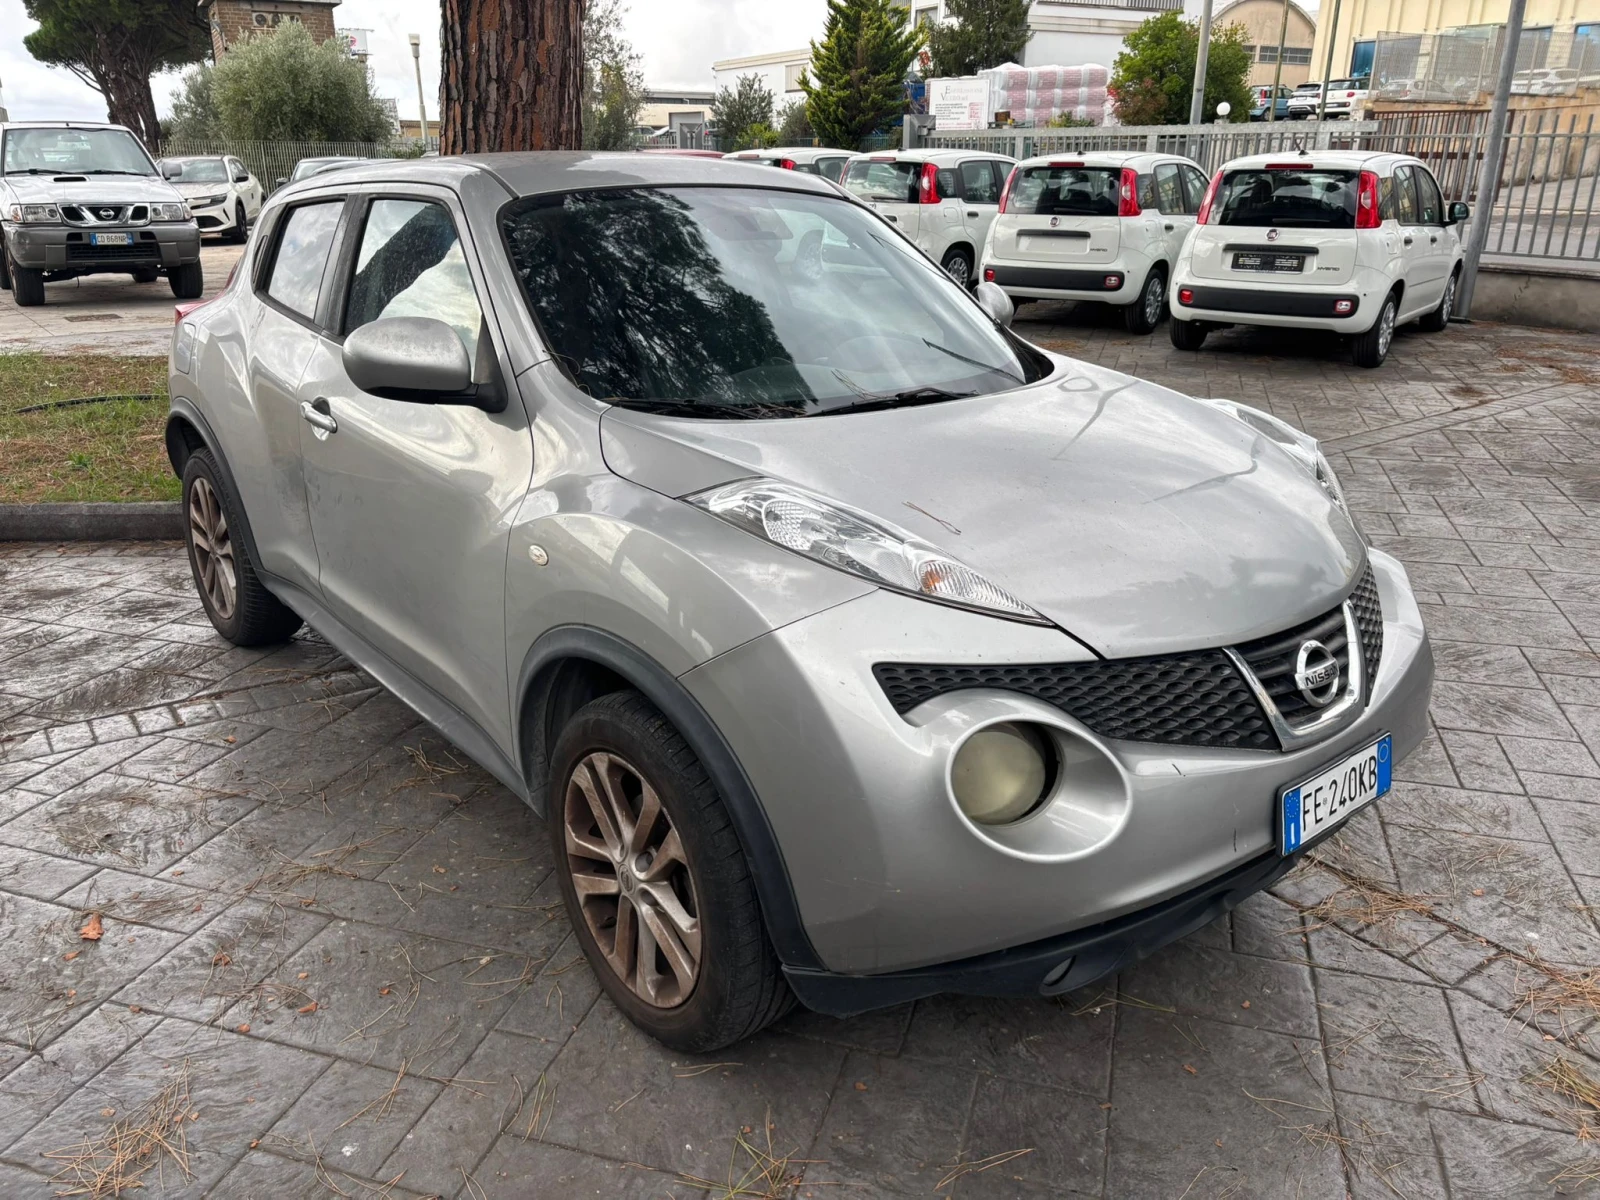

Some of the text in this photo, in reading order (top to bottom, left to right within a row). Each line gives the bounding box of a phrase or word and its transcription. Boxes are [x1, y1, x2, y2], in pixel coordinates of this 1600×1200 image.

[1304, 664, 1338, 687] NISSAN
[1302, 786, 1324, 832] FE
[1328, 755, 1377, 816] 240KB
